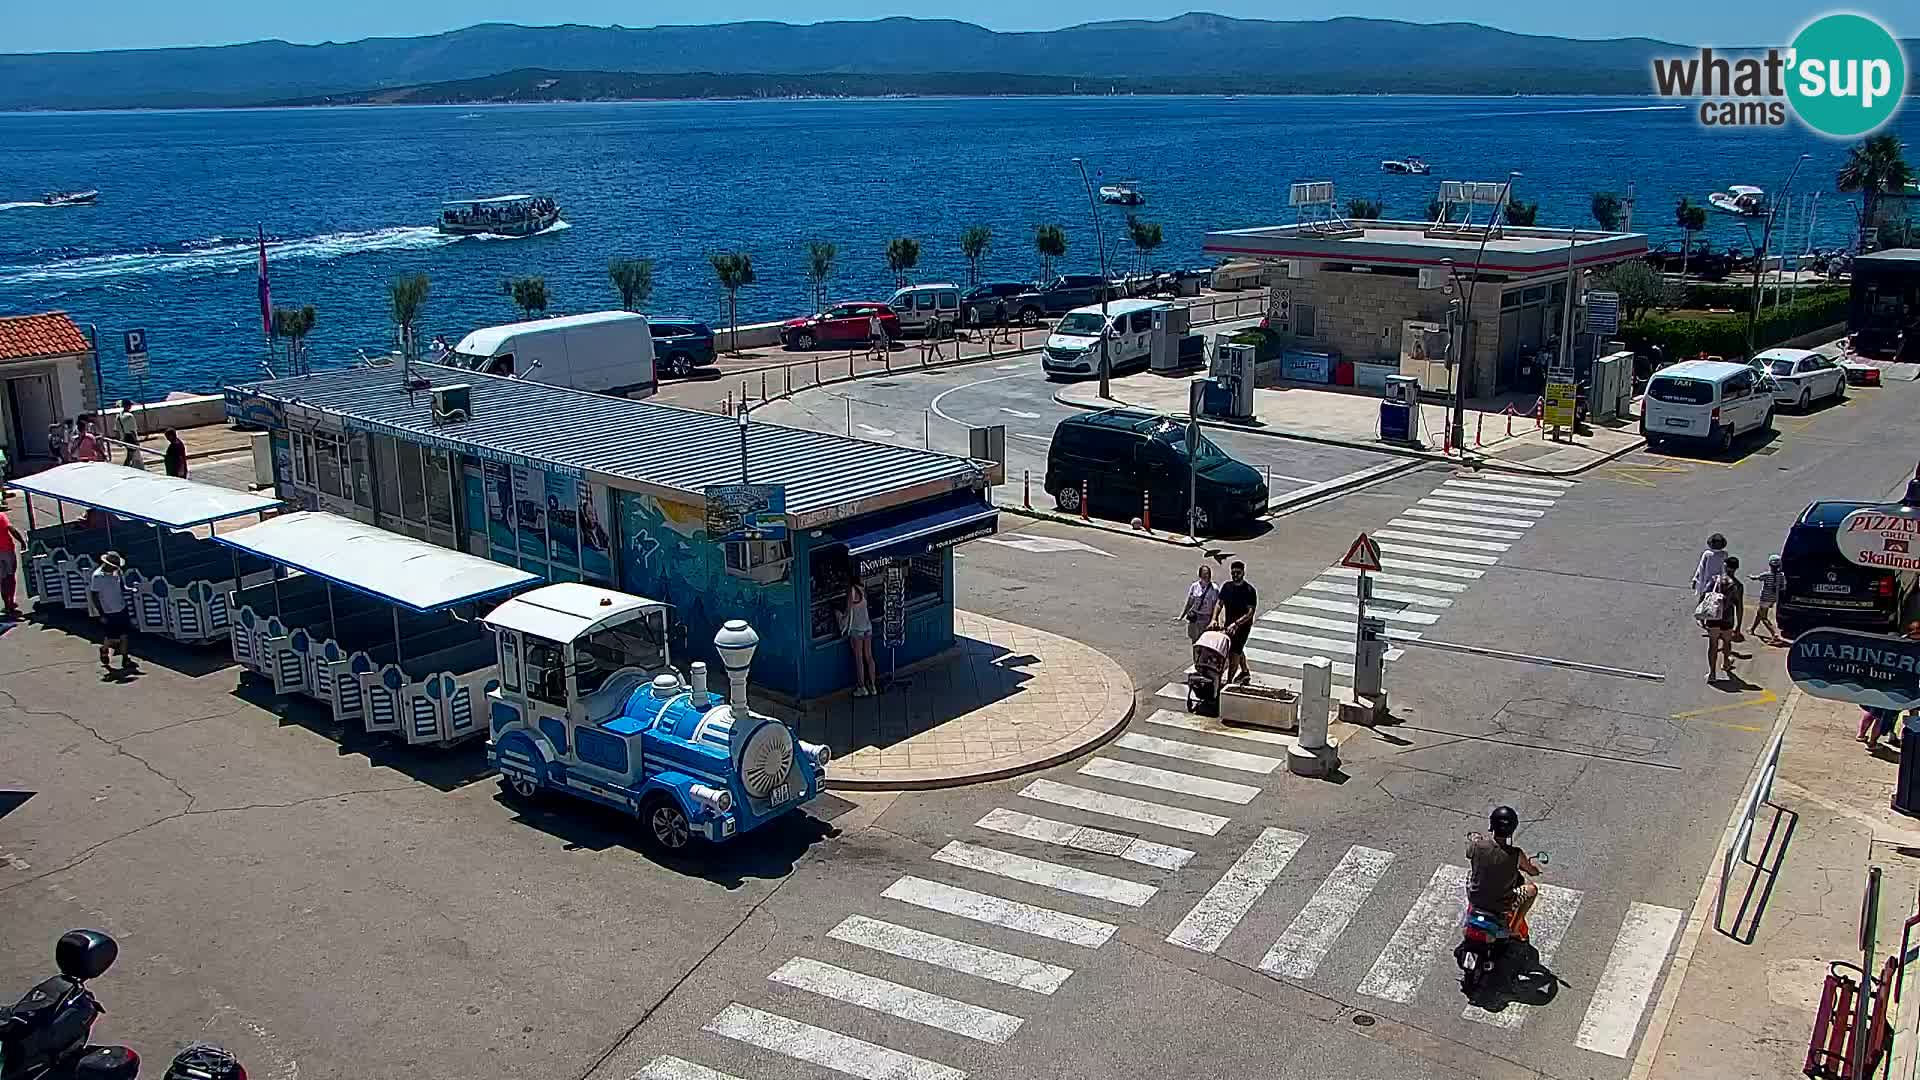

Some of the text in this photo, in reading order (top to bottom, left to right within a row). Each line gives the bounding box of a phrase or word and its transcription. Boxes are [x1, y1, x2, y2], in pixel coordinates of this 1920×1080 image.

[129, 333, 141, 350] P
[477, 447, 492, 458] BUS
[494, 451, 525, 465] STATION
[528, 460, 552, 472] TICKET
[554, 464, 581, 478] OFFICE
[1848, 516, 1920, 534] PIZZE
[1828, 663, 1896, 680] caffe bar
